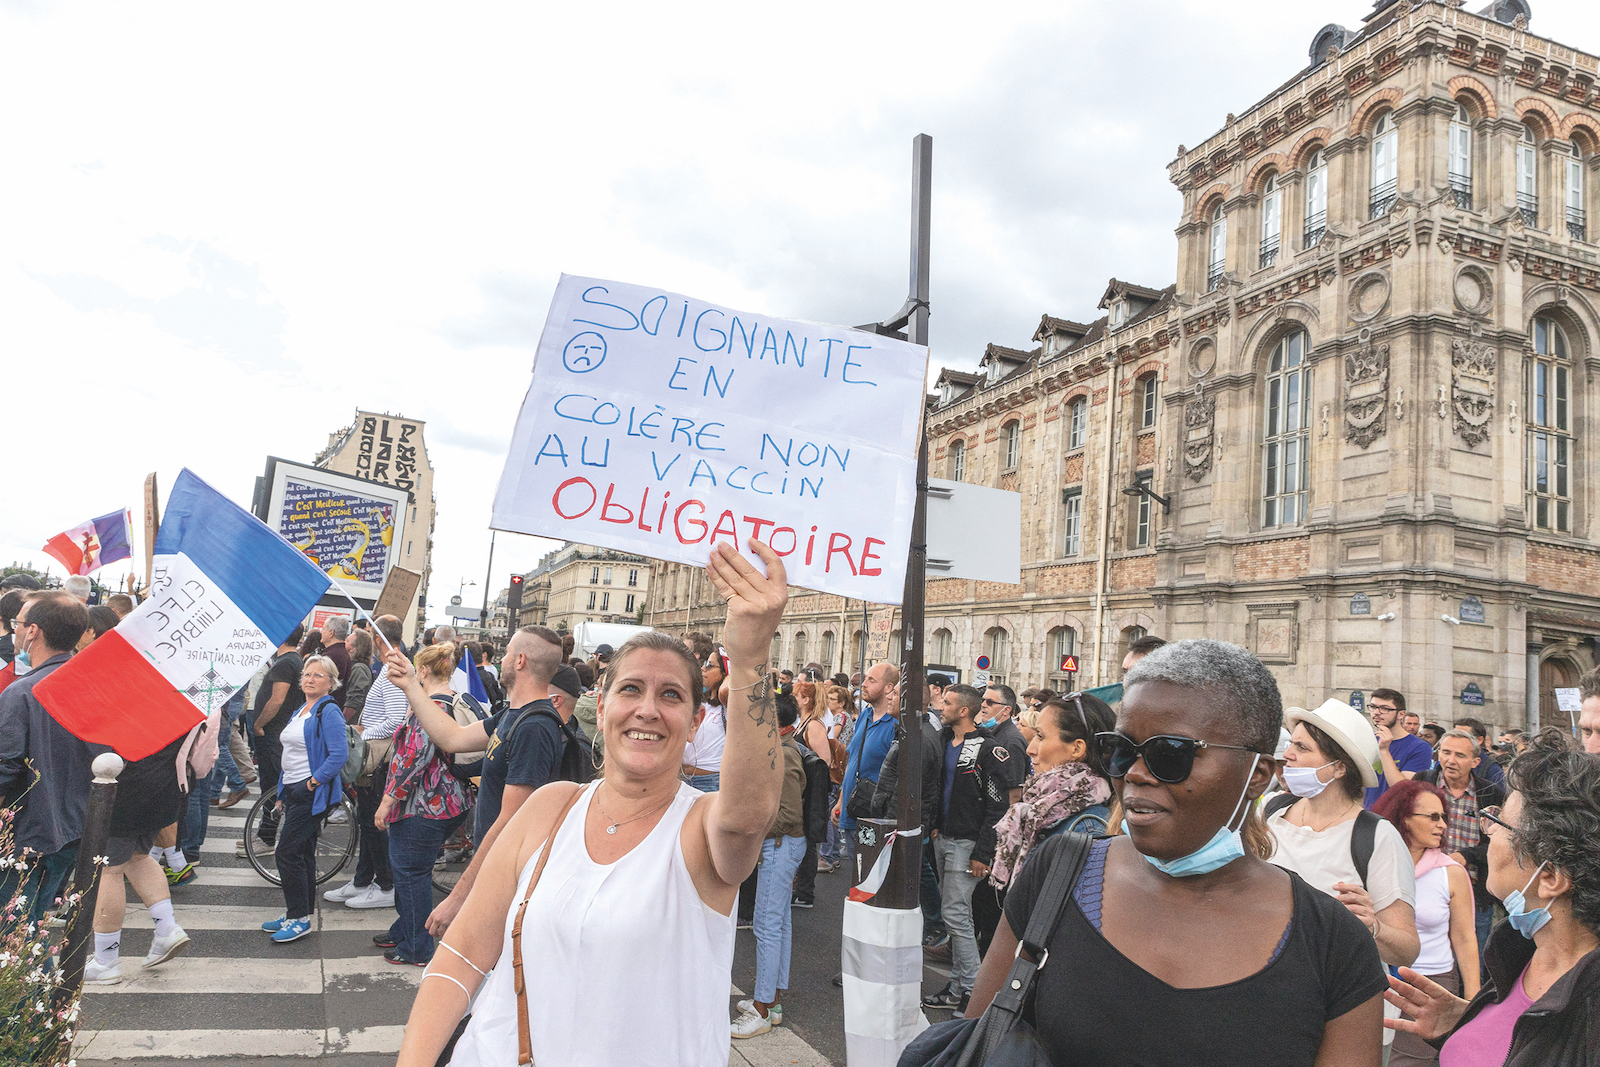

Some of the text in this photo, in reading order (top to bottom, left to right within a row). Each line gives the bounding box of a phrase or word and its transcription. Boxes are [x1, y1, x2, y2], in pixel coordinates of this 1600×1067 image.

[669, 357, 734, 398] EN
[534, 434, 609, 468] AU
[554, 394, 850, 472] COLÈRE NON
